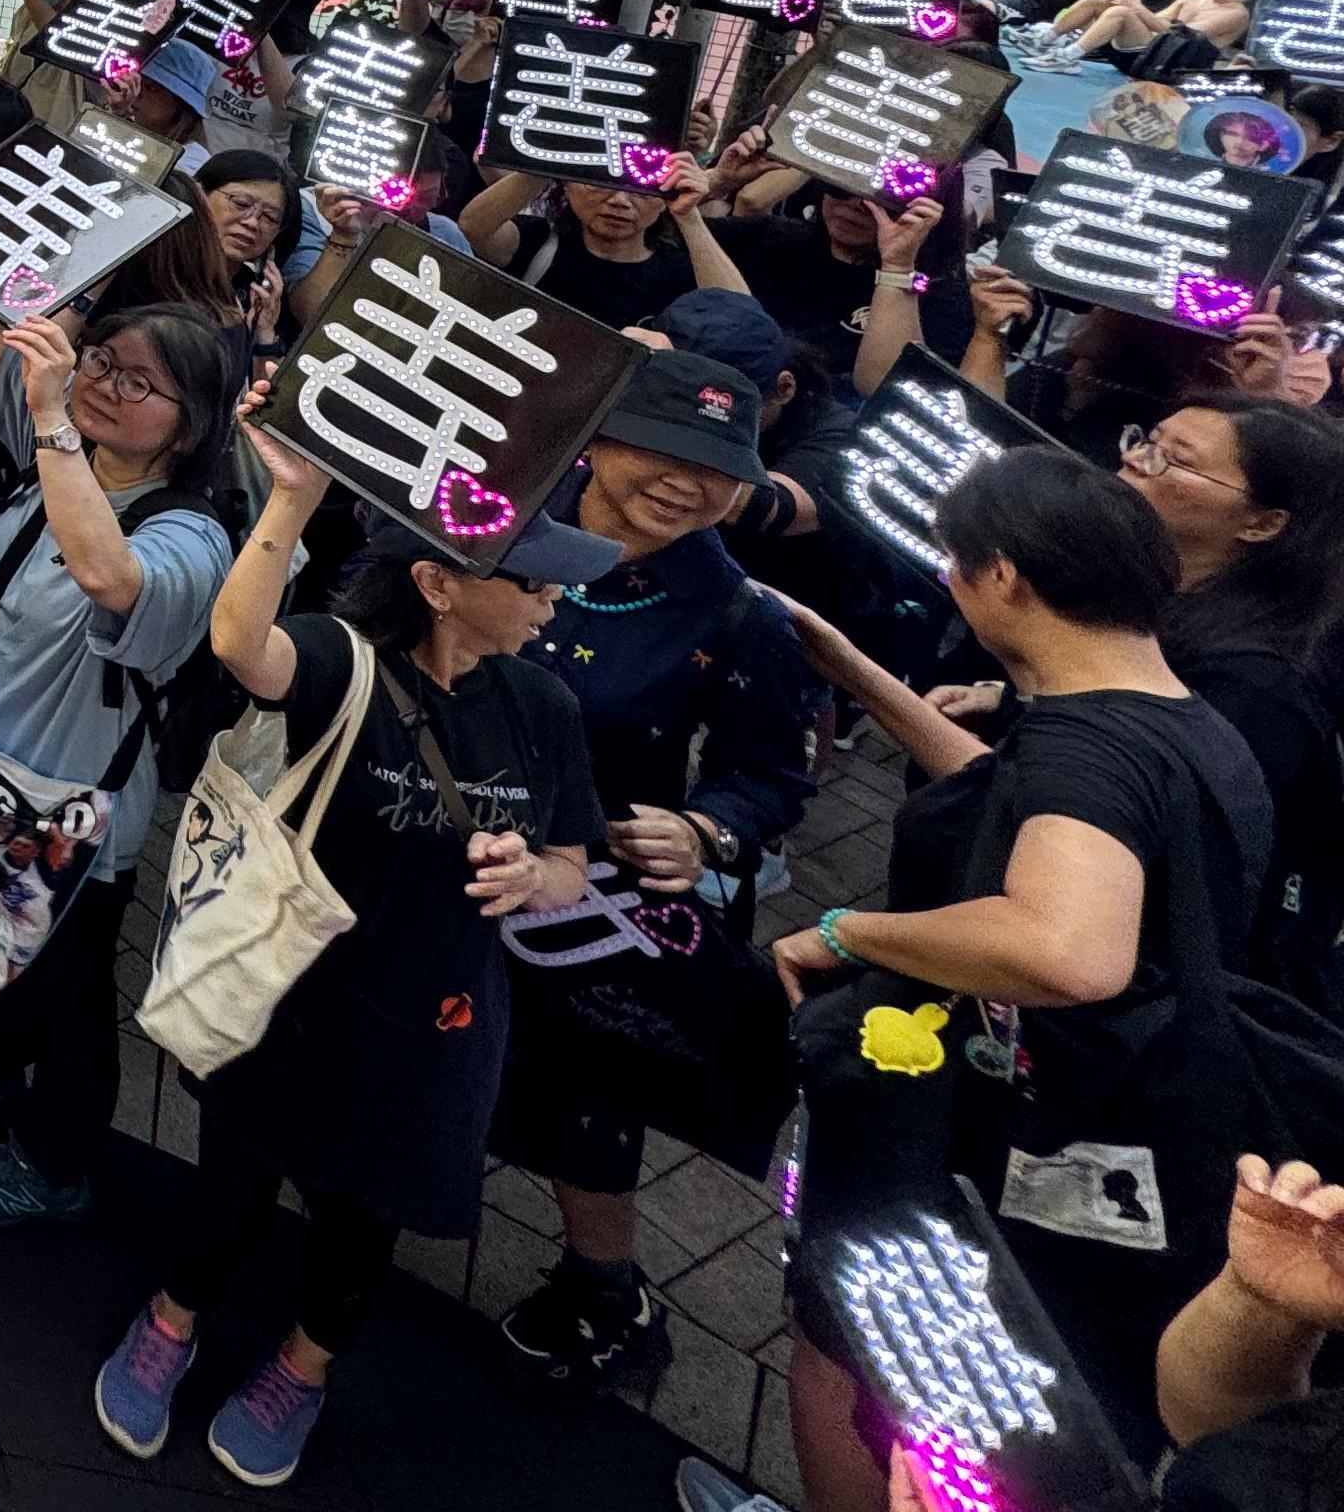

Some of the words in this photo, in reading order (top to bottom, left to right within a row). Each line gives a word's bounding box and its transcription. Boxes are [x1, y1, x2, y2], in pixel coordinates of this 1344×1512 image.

[314, 106, 408, 196] 姜
[498, 32, 657, 177] 姜
[788, 46, 963, 188] 姜
[1019, 147, 1253, 309] 姜
[298, 255, 558, 510] 姜
